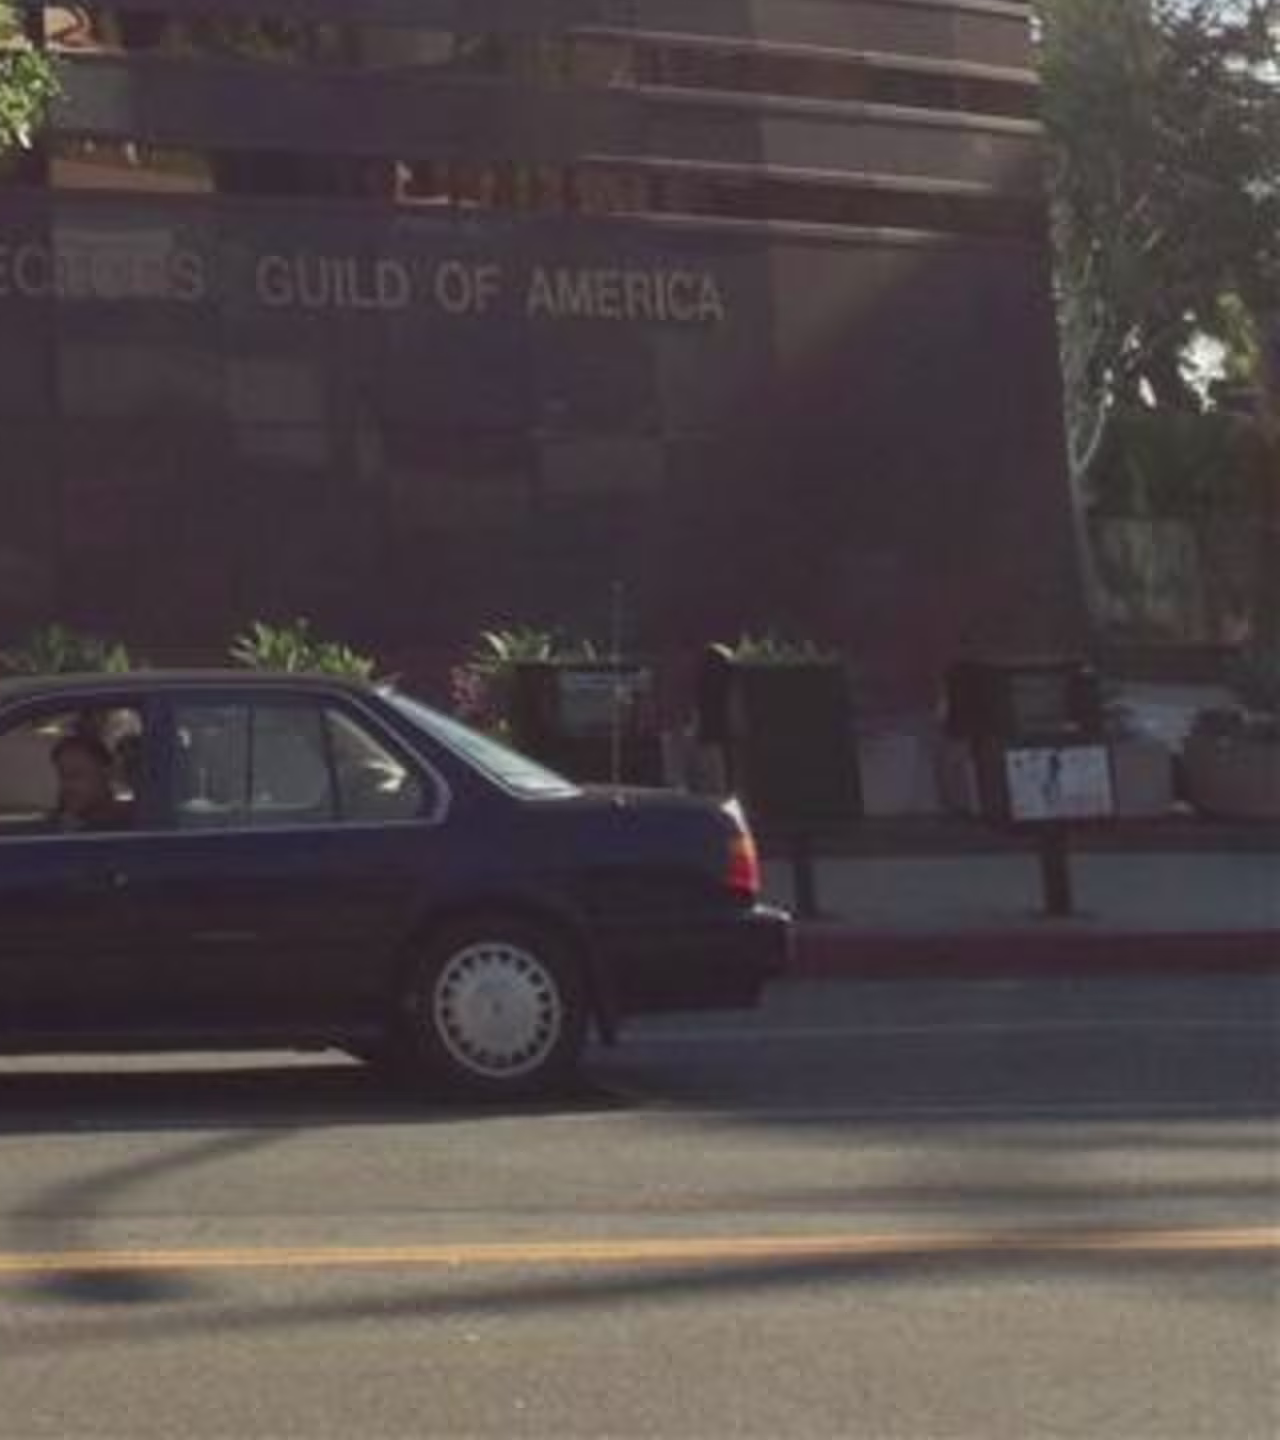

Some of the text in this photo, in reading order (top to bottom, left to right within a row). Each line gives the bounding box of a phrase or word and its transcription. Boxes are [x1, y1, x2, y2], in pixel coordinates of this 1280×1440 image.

[255, 254, 411, 309] GUILD
[439, 260, 502, 314] OF
[527, 266, 726, 320] AMERICA
